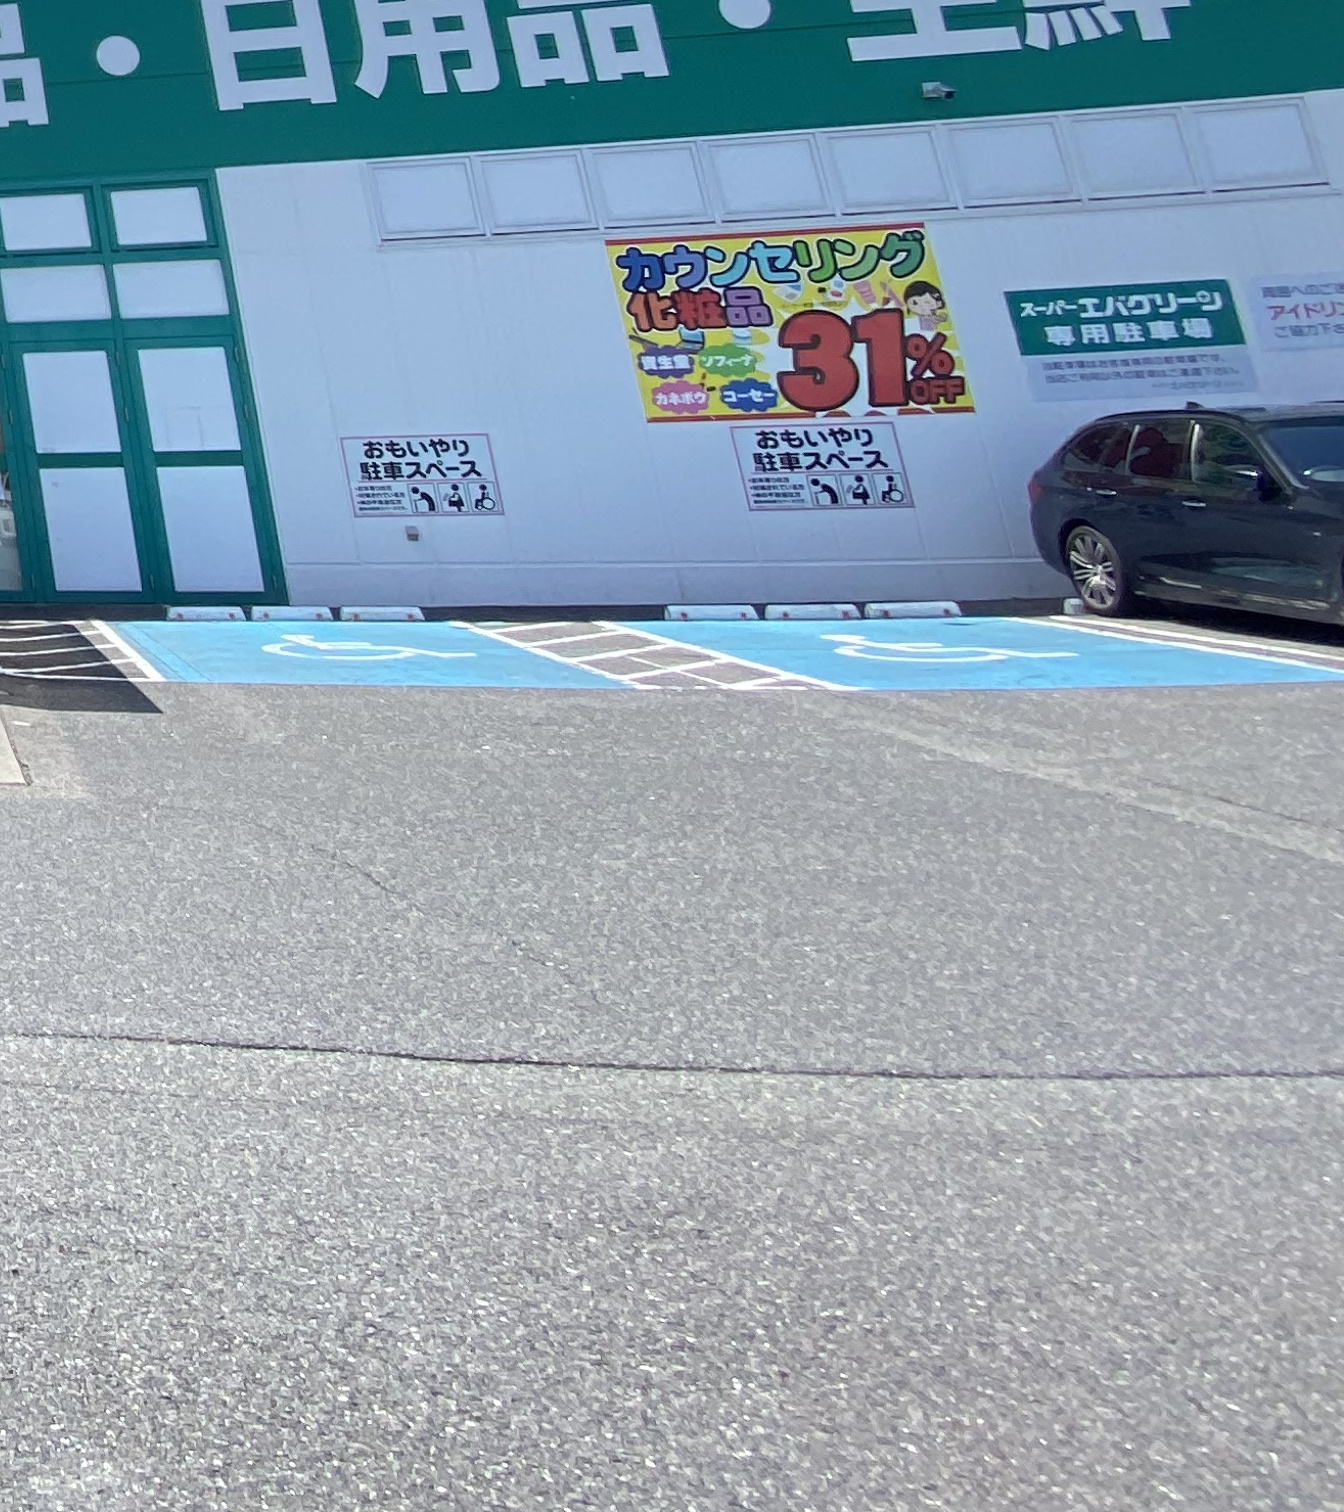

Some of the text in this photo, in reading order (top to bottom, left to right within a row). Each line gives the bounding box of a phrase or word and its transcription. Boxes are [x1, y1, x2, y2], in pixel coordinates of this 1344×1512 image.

[616, 230, 925, 293] カウンセリング
[626, 286, 773, 332] 化粧品
[1020, 290, 1223, 319] スーパー エバグリーン
[1044, 317, 1213, 346] 専用駐車場
[723, 389, 775, 404] コーセー
[912, 377, 966, 405] OFF
[363, 438, 470, 459] おもいやり
[755, 427, 873, 449] おもいやり
[360, 460, 482, 480] 駐車スペース
[752, 451, 889, 471] 駐車スペース
